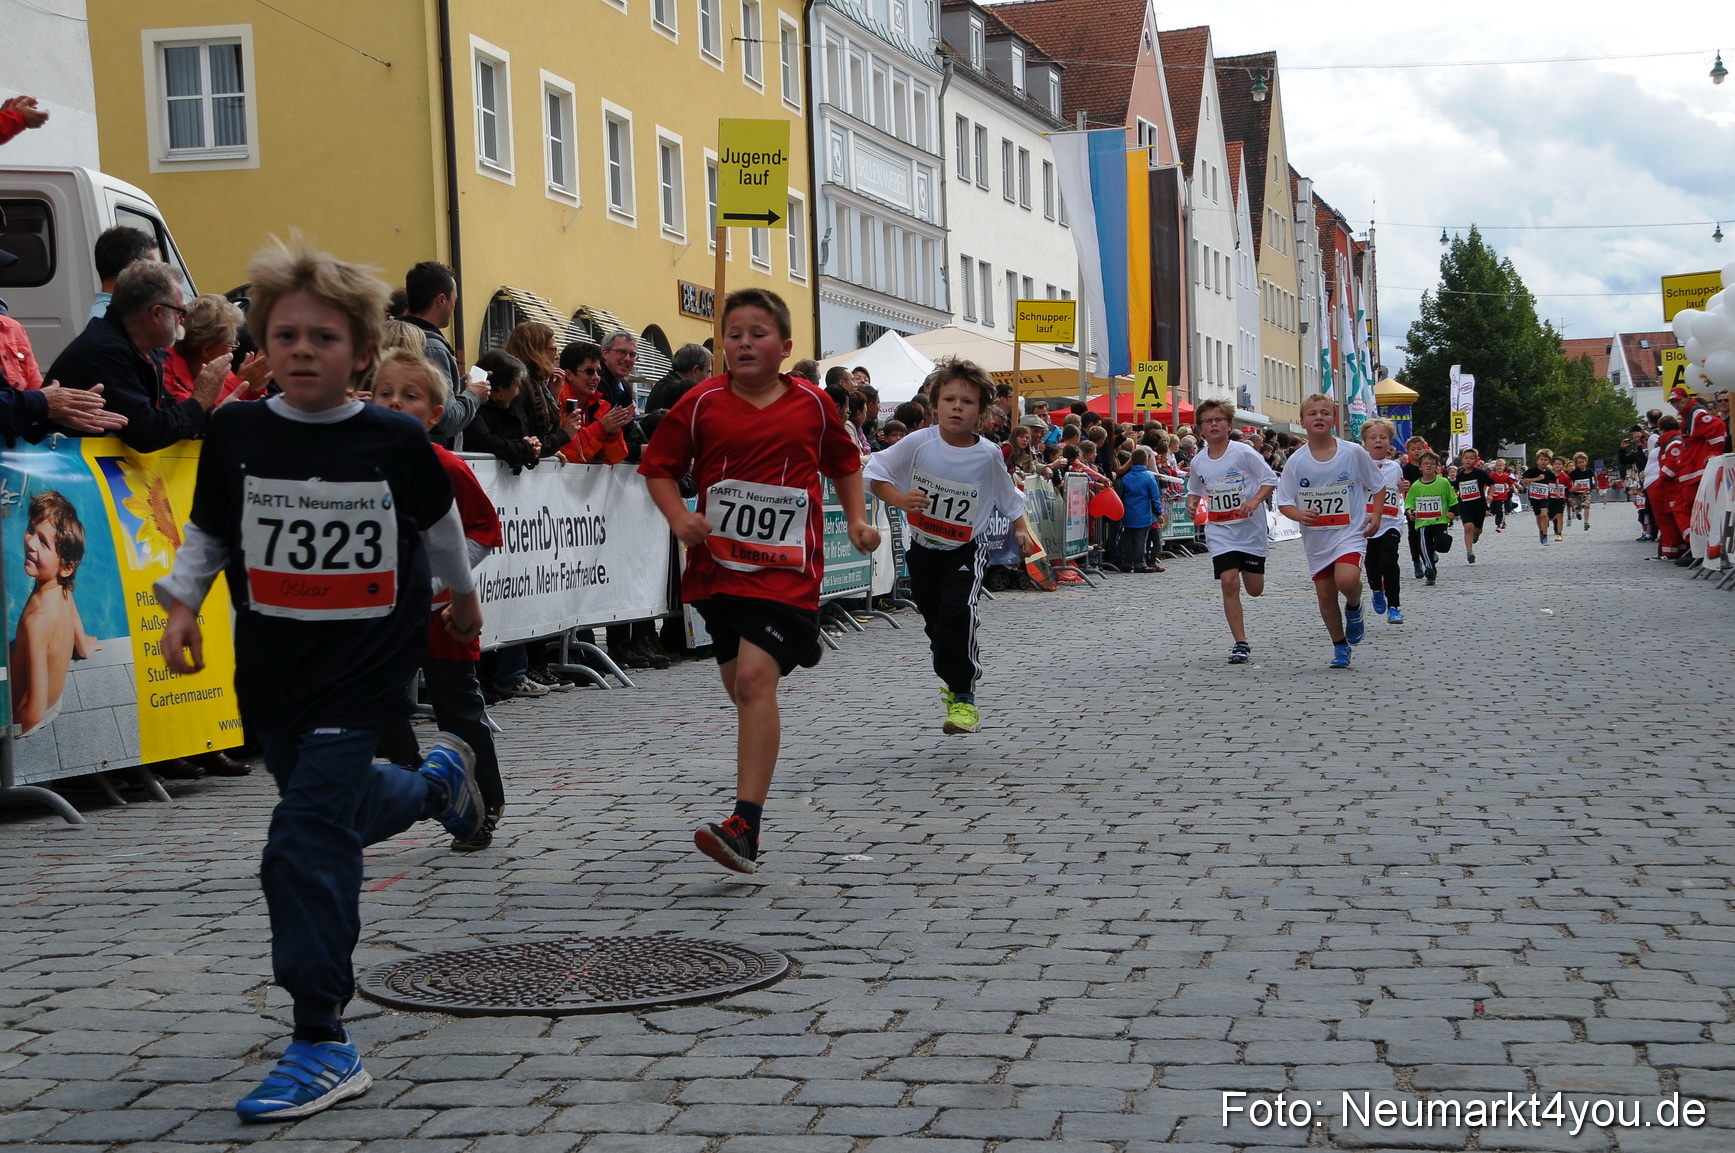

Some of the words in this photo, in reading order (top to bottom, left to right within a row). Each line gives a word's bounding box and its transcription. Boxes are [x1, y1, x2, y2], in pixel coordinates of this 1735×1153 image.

[721, 148, 788, 168] Jugend-
[739, 169, 769, 185] lauf
[1686, 298, 1705, 309] lauf
[1019, 312, 1071, 323] Schnupper-
[1036, 325, 1053, 333] lauf
[1138, 363, 1164, 372] Block
[1140, 376, 1160, 399] A
[1455, 418, 1463, 429] B
[710, 486, 744, 499] PARTL
[746, 491, 793, 505] Neumarkt
[913, 475, 934, 489] PARTL
[935, 484, 969, 497] Neumarkt
[247, 491, 294, 508] PARTL
[299, 496, 375, 510] Neumarkt
[1209, 493, 1241, 510] 7105
[1304, 497, 1344, 515] 7372
[1418, 502, 1439, 511] 7110
[719, 500, 796, 541] 7097
[258, 517, 382, 570] 7323
[731, 543, 776, 562] Lorenz
[480, 570, 534, 603] Verbrauch.
[536, 564, 559, 595] Mehr
[150, 686, 224, 708] Gartenmauern
